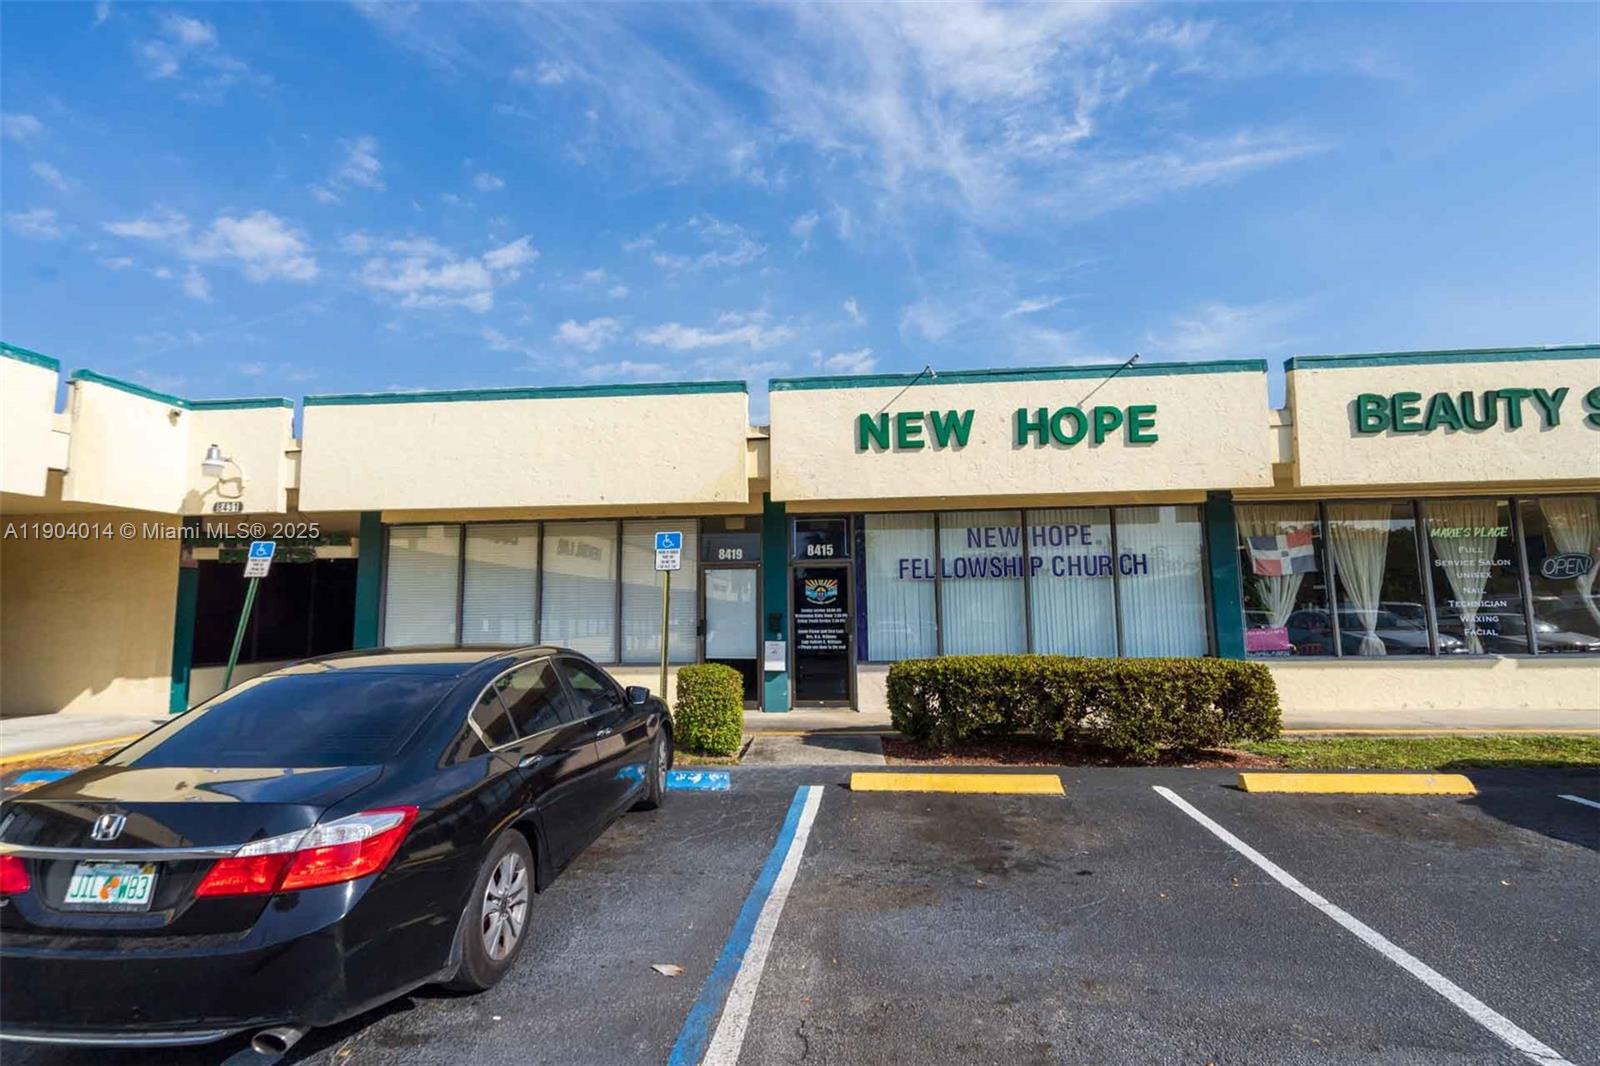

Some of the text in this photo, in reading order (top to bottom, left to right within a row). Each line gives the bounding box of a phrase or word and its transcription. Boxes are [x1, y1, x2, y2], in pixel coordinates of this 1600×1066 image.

[1350, 387, 1570, 435] BEAUTY
[857, 404, 1160, 452] NEW HOPE
[966, 525, 1093, 549] NEW HOPE
[1473, 526, 1509, 538] PLACE
[718, 548, 743, 560] 8419
[807, 544, 834, 556] 8415
[899, 554, 1148, 580] FELLOWSHIP CHURCH
[1543, 558, 1589, 575] OPEN
